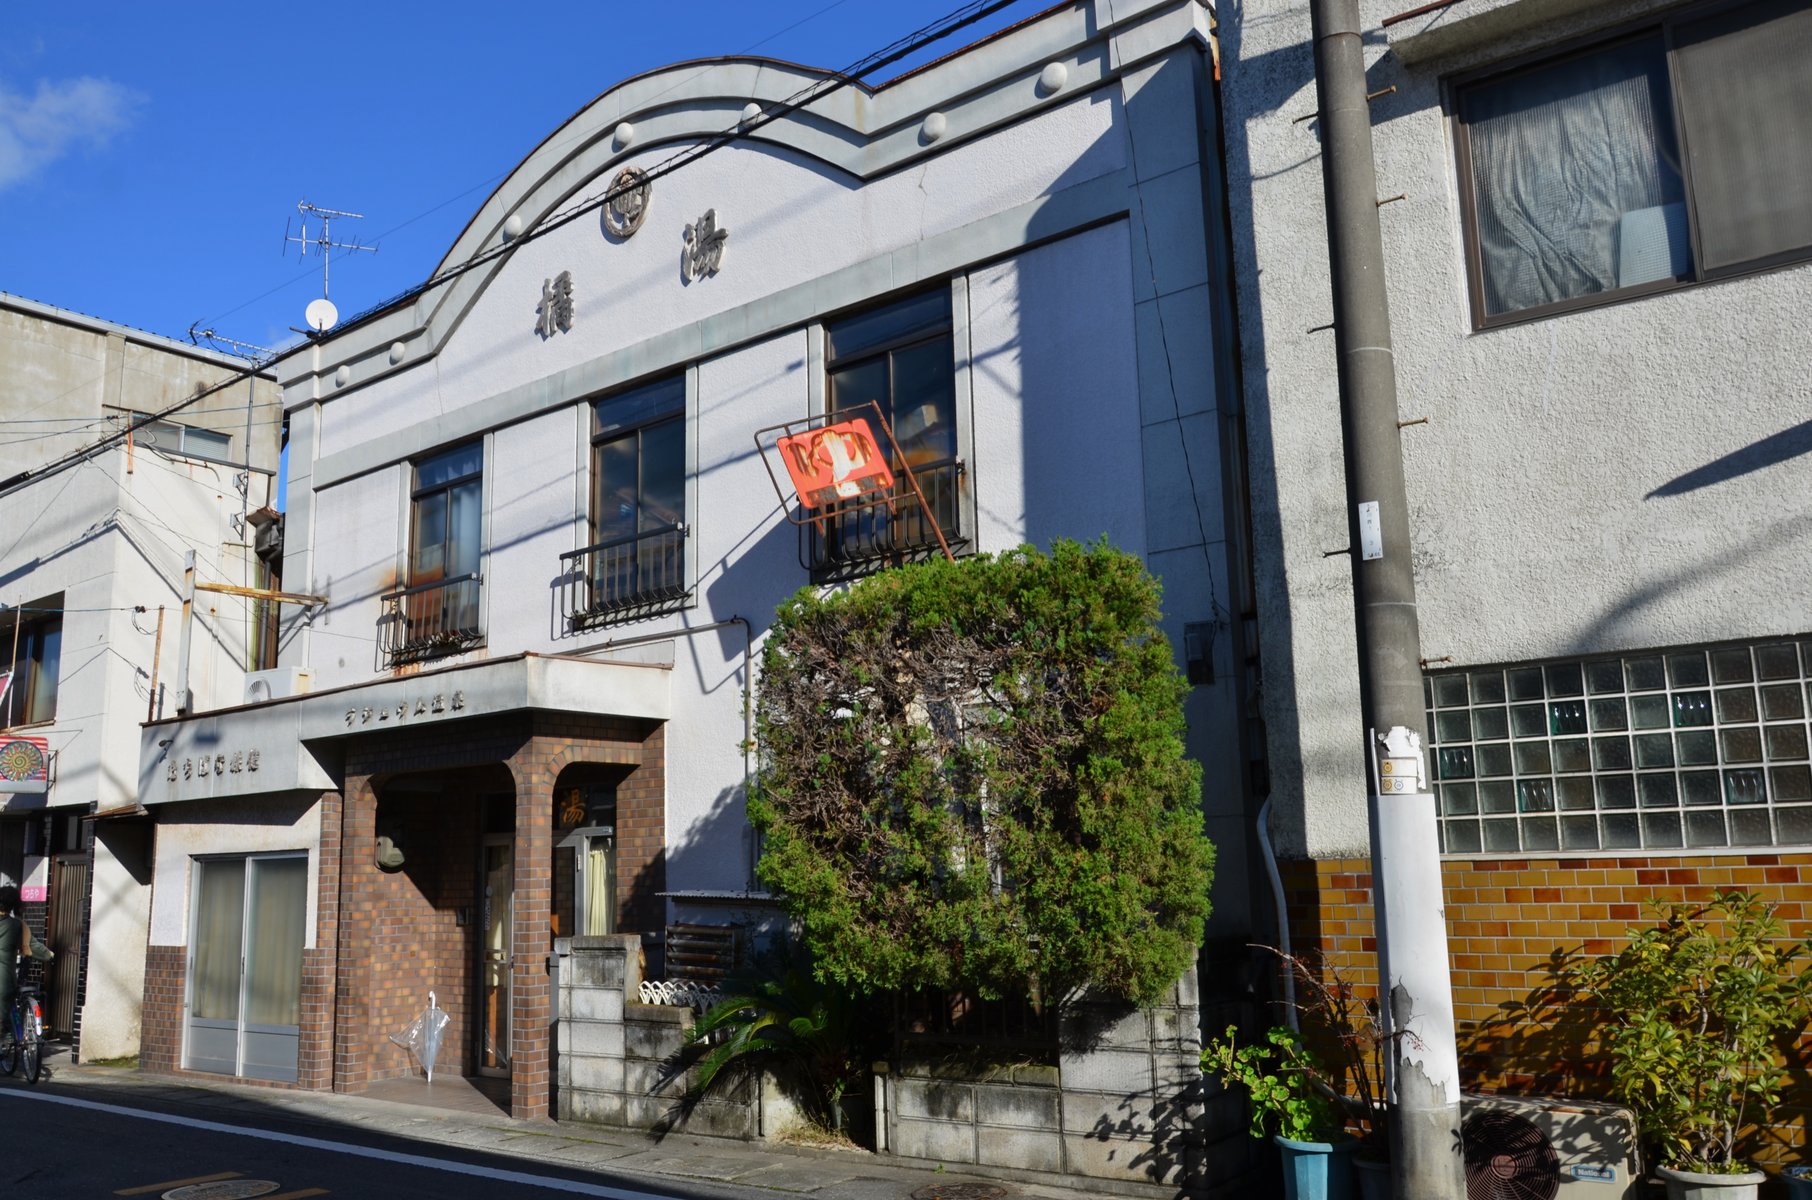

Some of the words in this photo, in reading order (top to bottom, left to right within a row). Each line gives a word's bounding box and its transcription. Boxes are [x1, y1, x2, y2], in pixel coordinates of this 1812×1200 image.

[167, 748, 260, 782] たちばな
[561, 788, 586, 824] 湯
